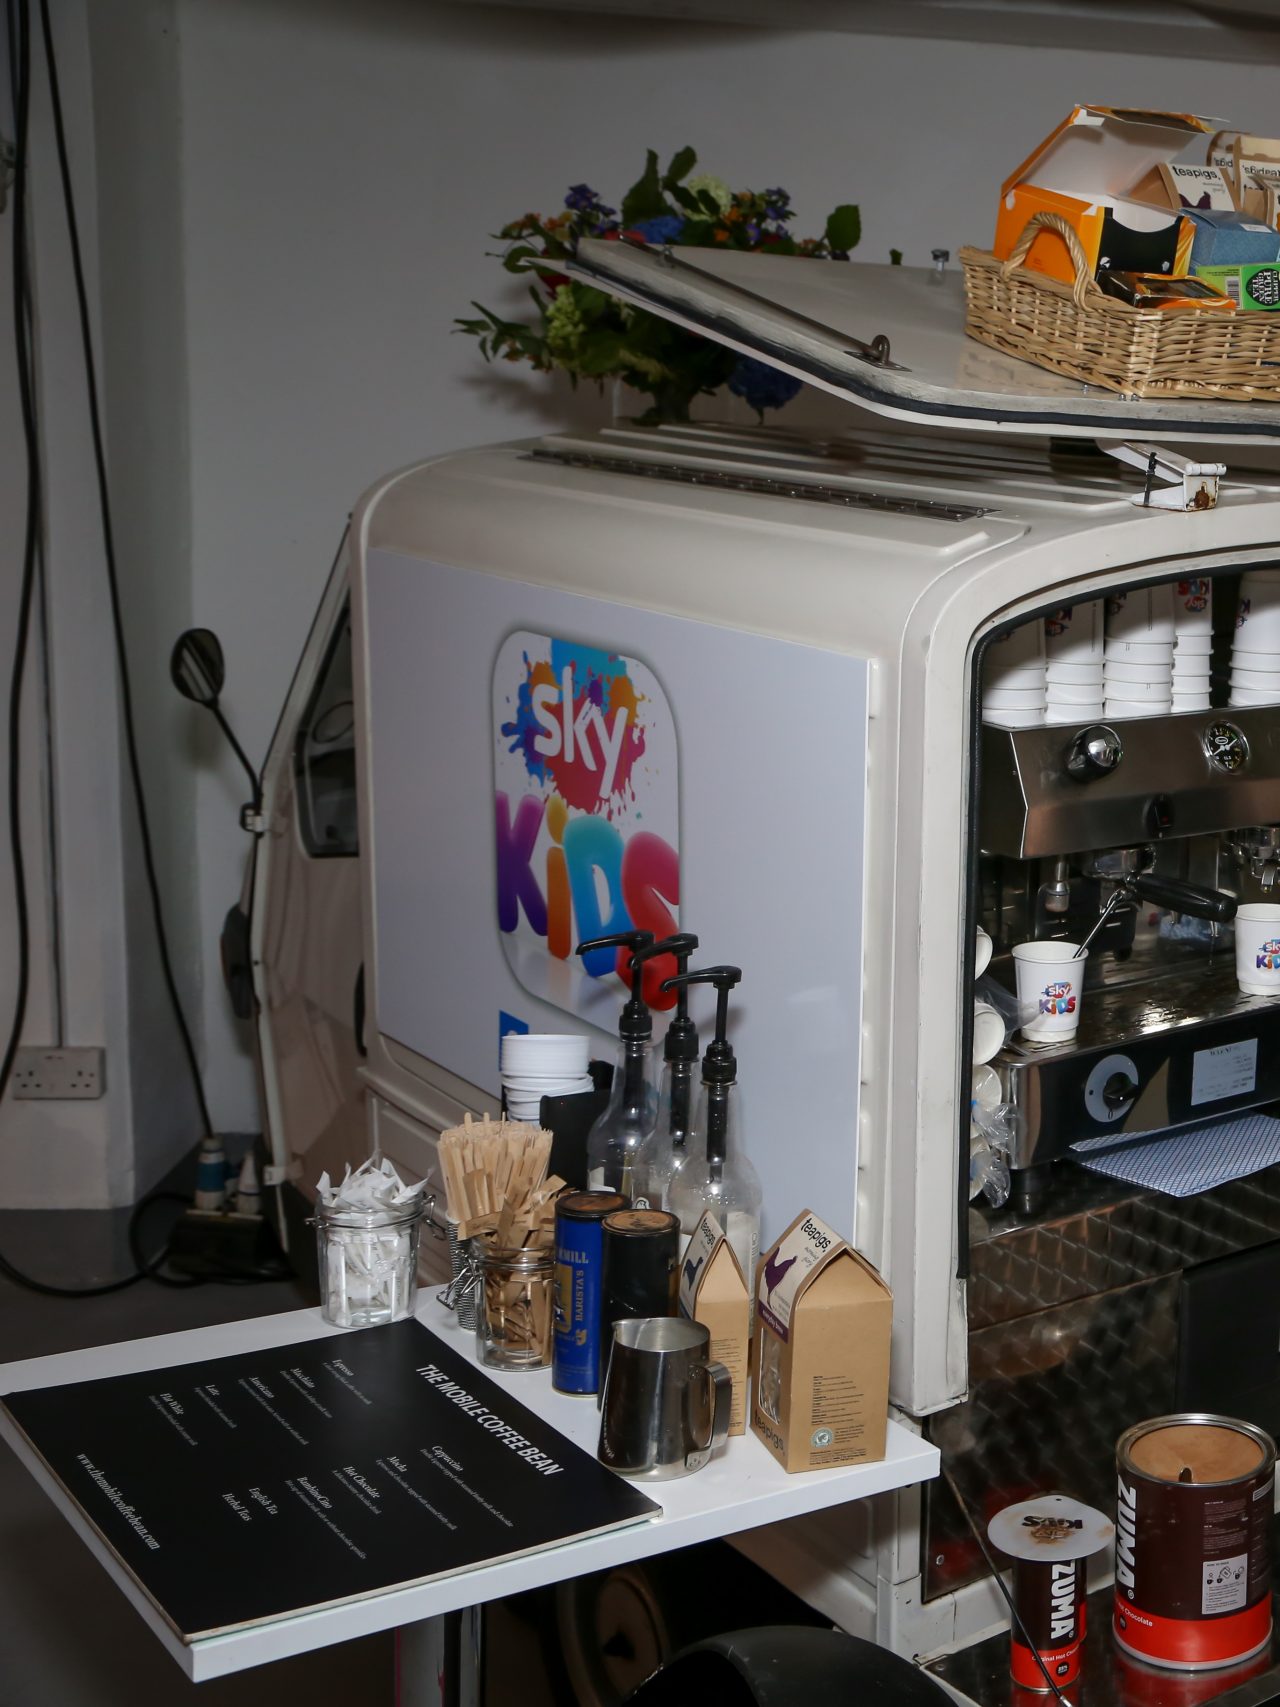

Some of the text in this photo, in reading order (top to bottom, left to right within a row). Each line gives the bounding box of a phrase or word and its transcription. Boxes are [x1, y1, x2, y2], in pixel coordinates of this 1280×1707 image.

[1252, 278, 1260, 298] TEA
[1264, 271, 1273, 304] PURE
[531, 666, 628, 799] sky
[575, 1269, 585, 1322] BARISTA'S
[416, 1364, 564, 1475] THE MOBILE COFFEE BEAN
[222, 1493, 252, 1521] Herbal Teas
[249, 1487, 278, 1515] English Tea
[1117, 1474, 1137, 1589] ZUMA
[1050, 1560, 1076, 1640] ZUMA
